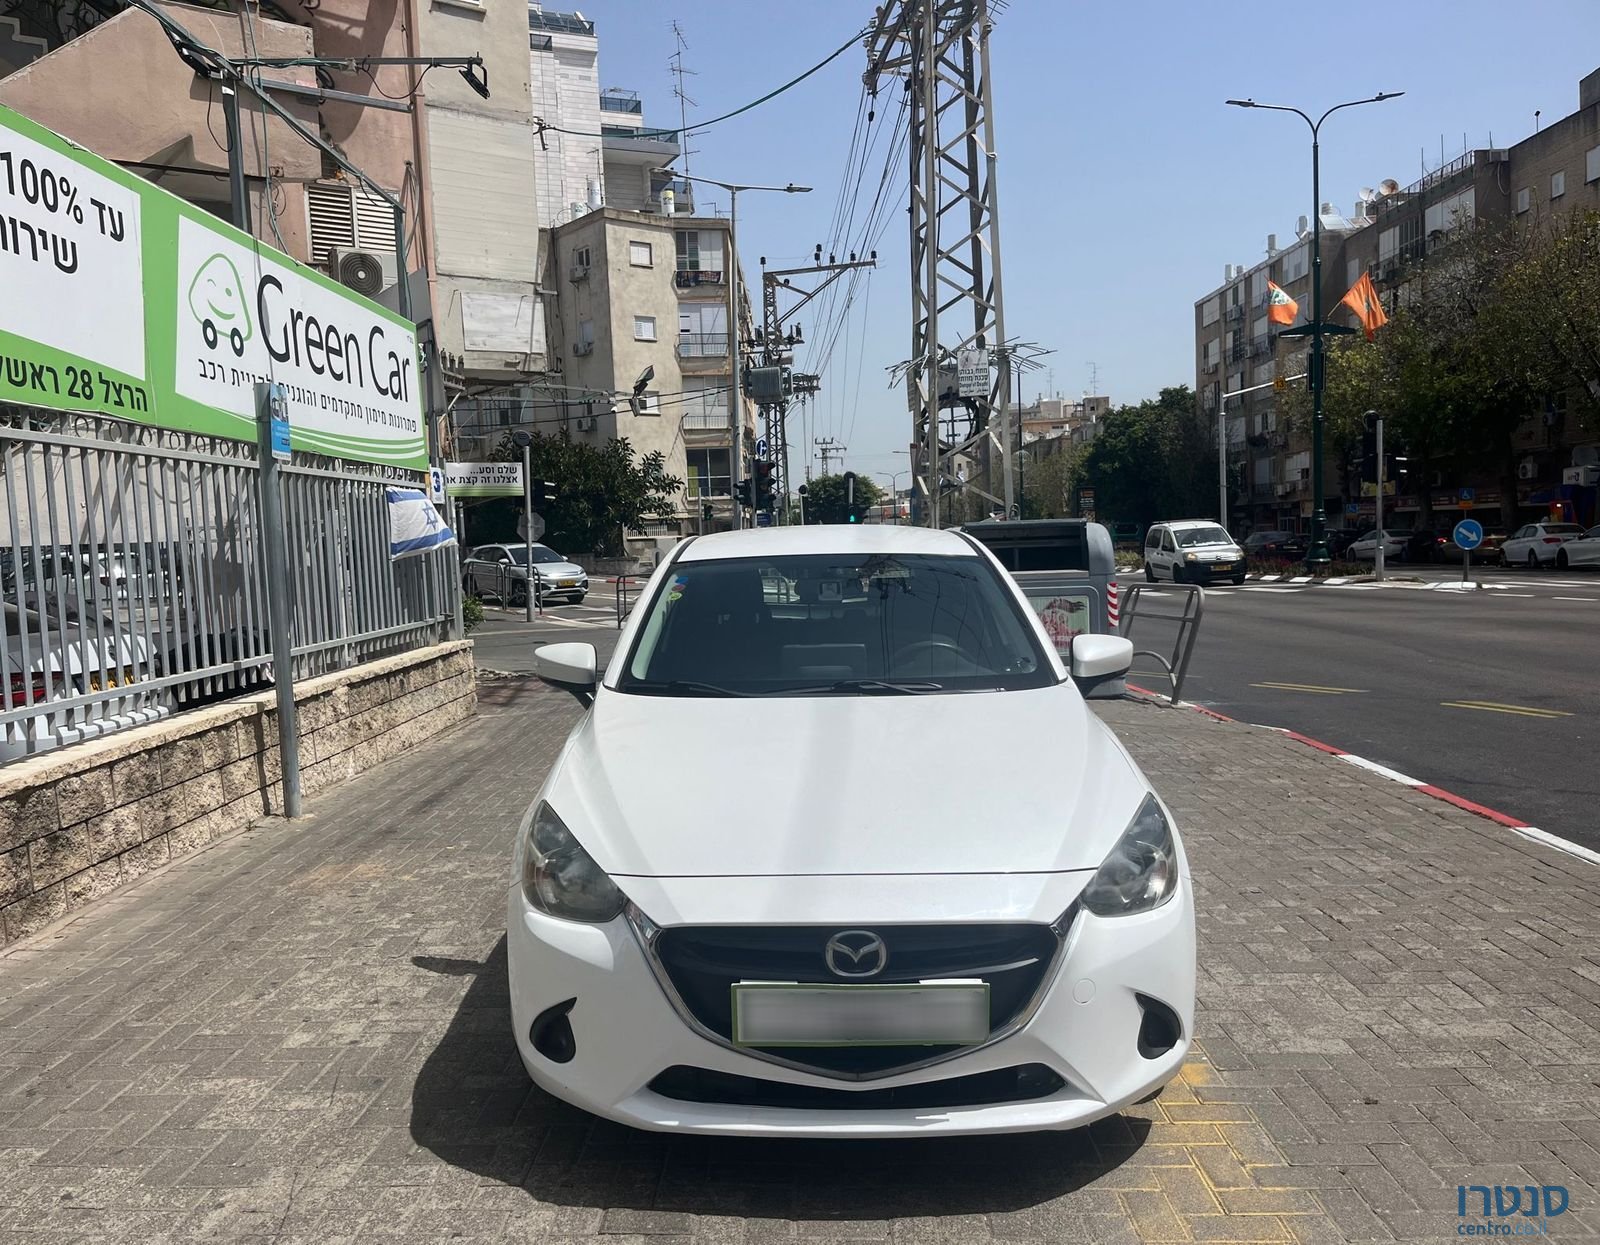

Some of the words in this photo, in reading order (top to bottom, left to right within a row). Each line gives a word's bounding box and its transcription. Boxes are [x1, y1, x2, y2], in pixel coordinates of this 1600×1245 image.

[0, 152, 84, 225] 100%
[90, 197, 124, 242] עד
[257, 274, 363, 388] Green
[369, 325, 410, 403] Car
[65, 366, 94, 400] 28
[198, 358, 226, 384] רכב
[98, 371, 148, 412] הרצל
[320, 394, 363, 420] מתקדמים
[365, 406, 387, 425] מימון
[388, 413, 417, 433] פתרונות
[458, 476, 478, 485] קצת
[480, 476, 491, 484] זה
[493, 475, 518, 484] אצלנו
[497, 465, 518, 474] שלם
